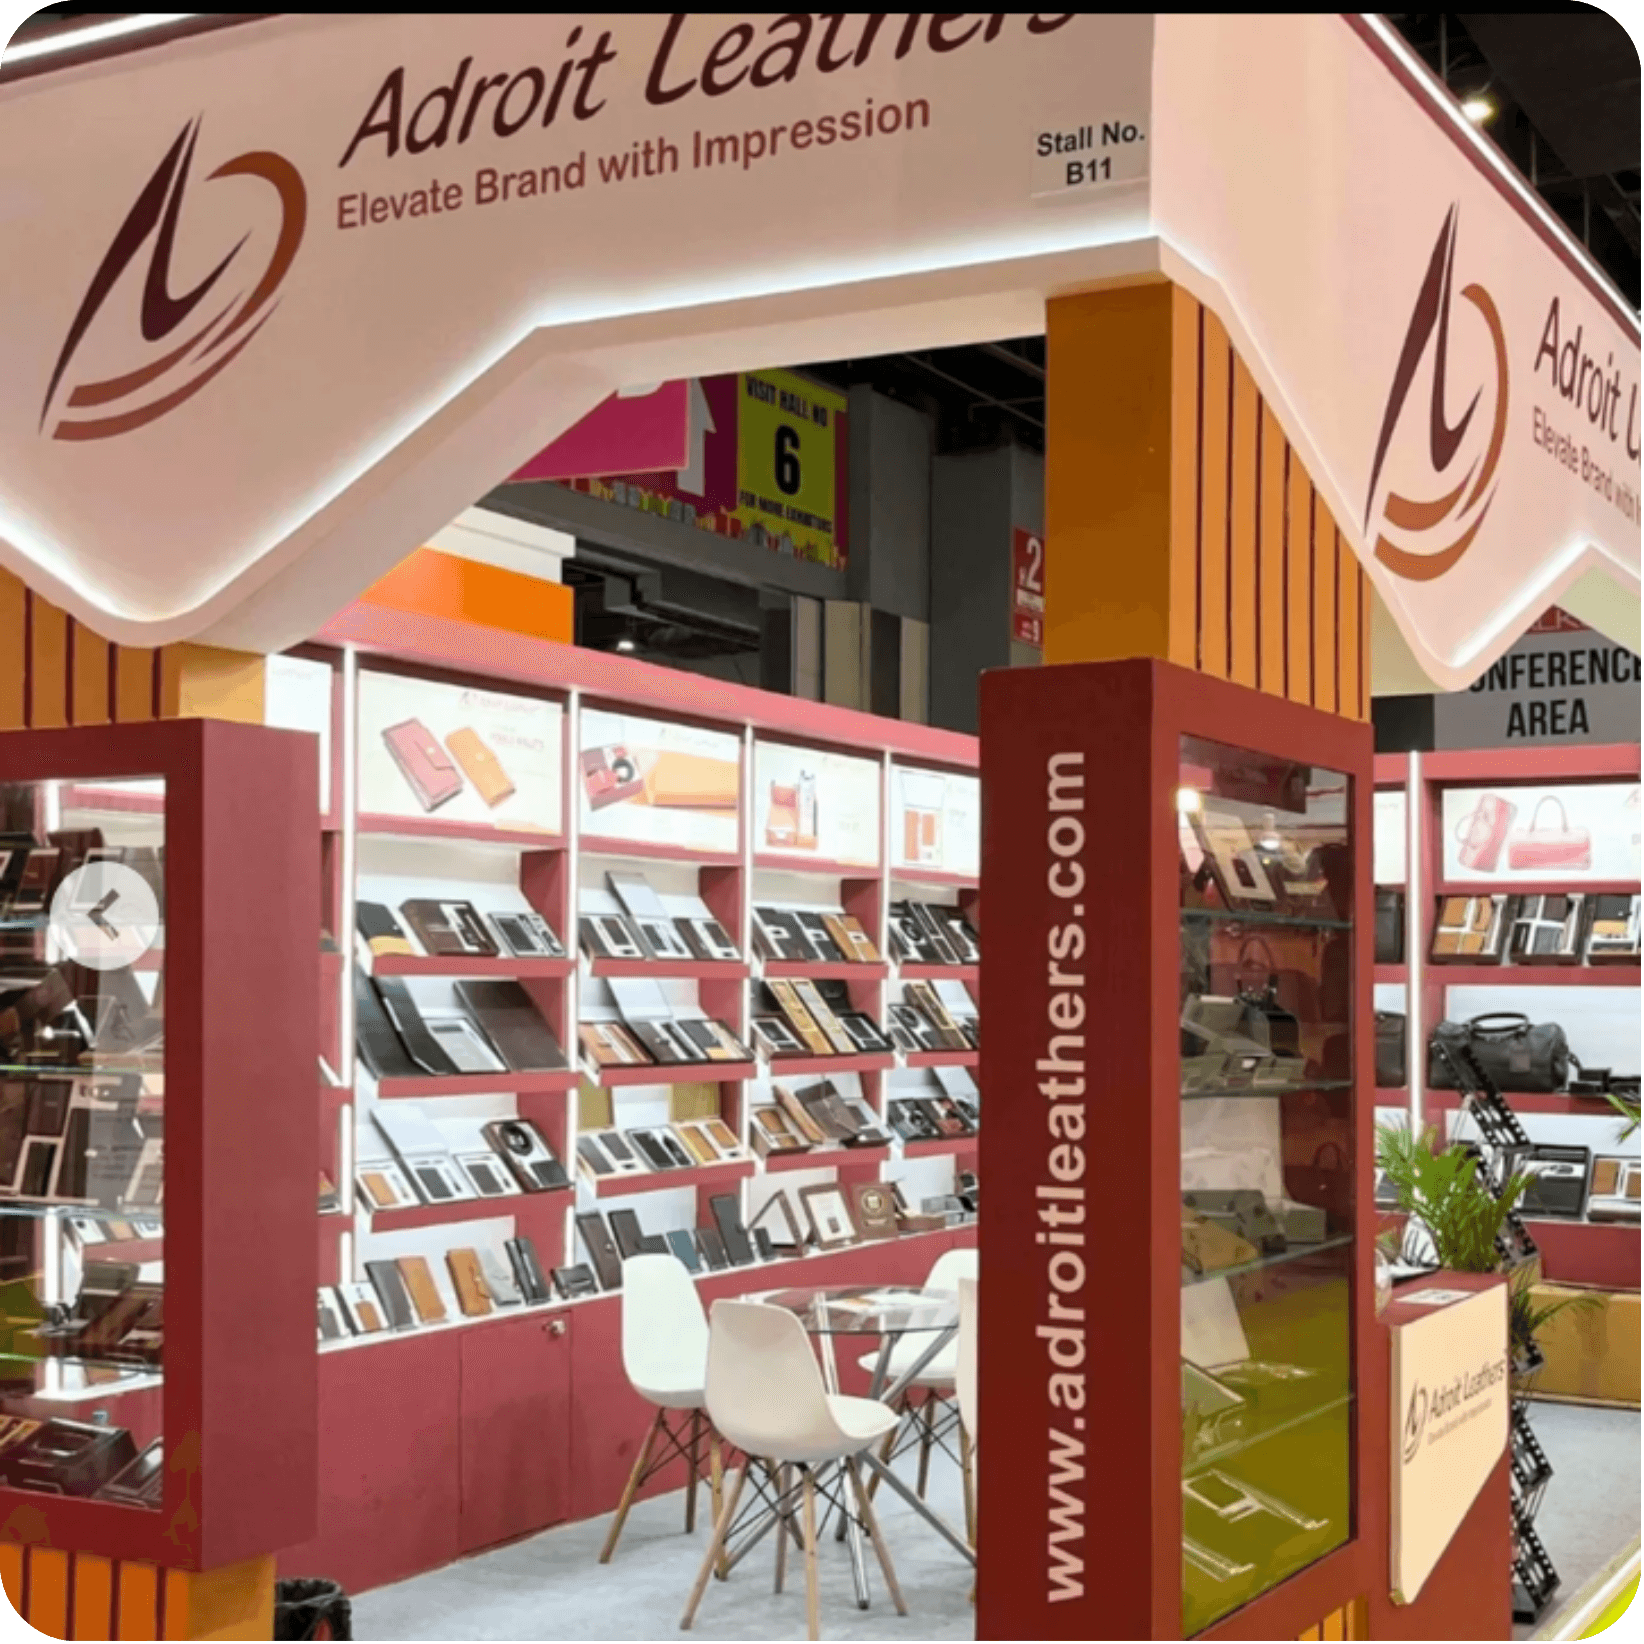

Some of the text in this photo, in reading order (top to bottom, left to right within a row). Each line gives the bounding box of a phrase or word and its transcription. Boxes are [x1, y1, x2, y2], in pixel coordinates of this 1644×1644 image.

[338, 25, 618, 168] Adroit
[337, 97, 930, 230] Elevate Brand with Impression
[1036, 121, 1146, 158] Stall No.
[1065, 157, 1112, 187] B11
[1533, 295, 1622, 443] Adroit
[774, 424, 801, 496] 6
[1533, 405, 1579, 475] Elevate
[1470, 646, 1641, 692] NFERENC
[1506, 698, 1590, 738] AREA
[1035, 752, 1086, 1602] www.adroitleathers.com
